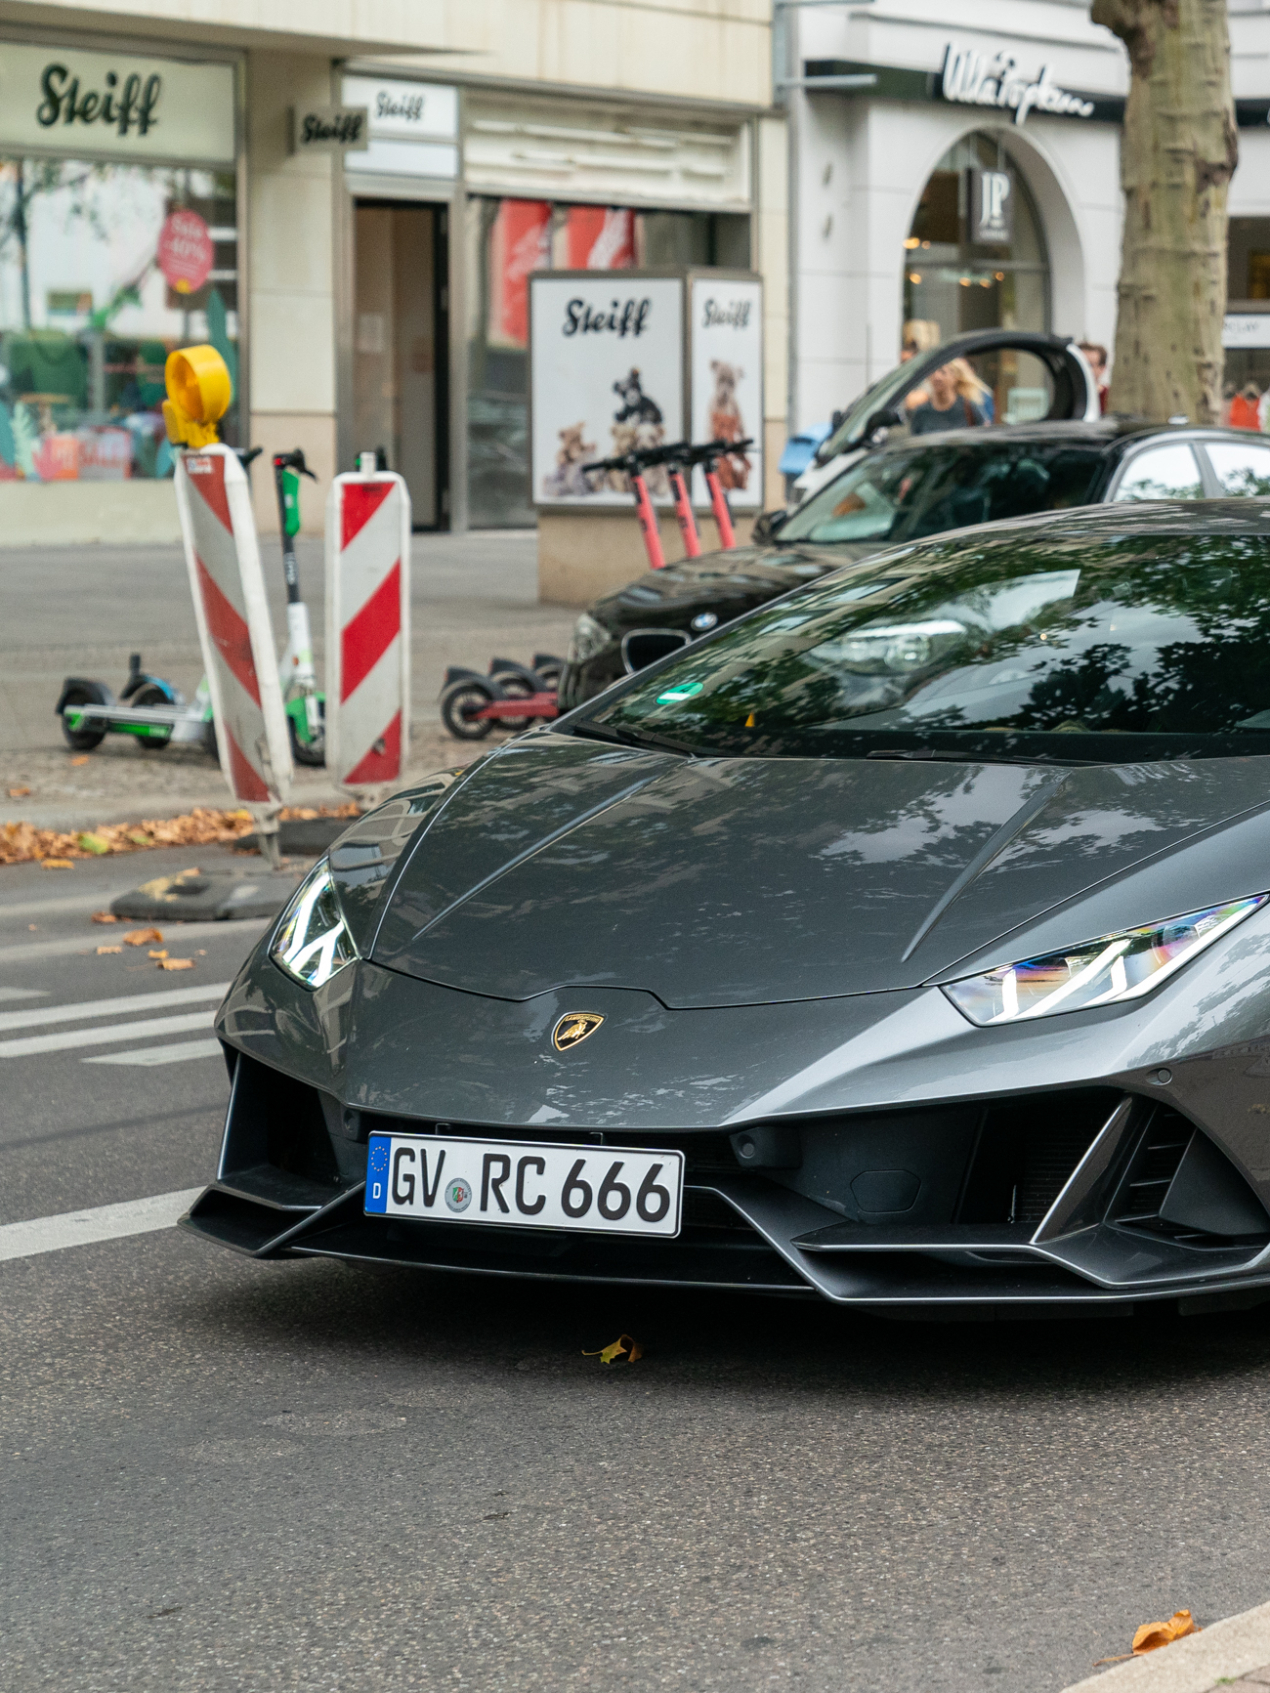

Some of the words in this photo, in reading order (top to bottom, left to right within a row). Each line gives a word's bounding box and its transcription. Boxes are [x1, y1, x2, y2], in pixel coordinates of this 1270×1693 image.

[36, 62, 162, 136] Steiff
[373, 90, 424, 121] Steiff
[301, 112, 363, 143] Steiff
[562, 298, 652, 338] Steiff
[702, 298, 751, 330] Steiff
[372, 1182, 381, 1199] D
[391, 1146, 447, 1208] GV
[479, 1153, 546, 1215] RC
[560, 1158, 670, 1223] 666
